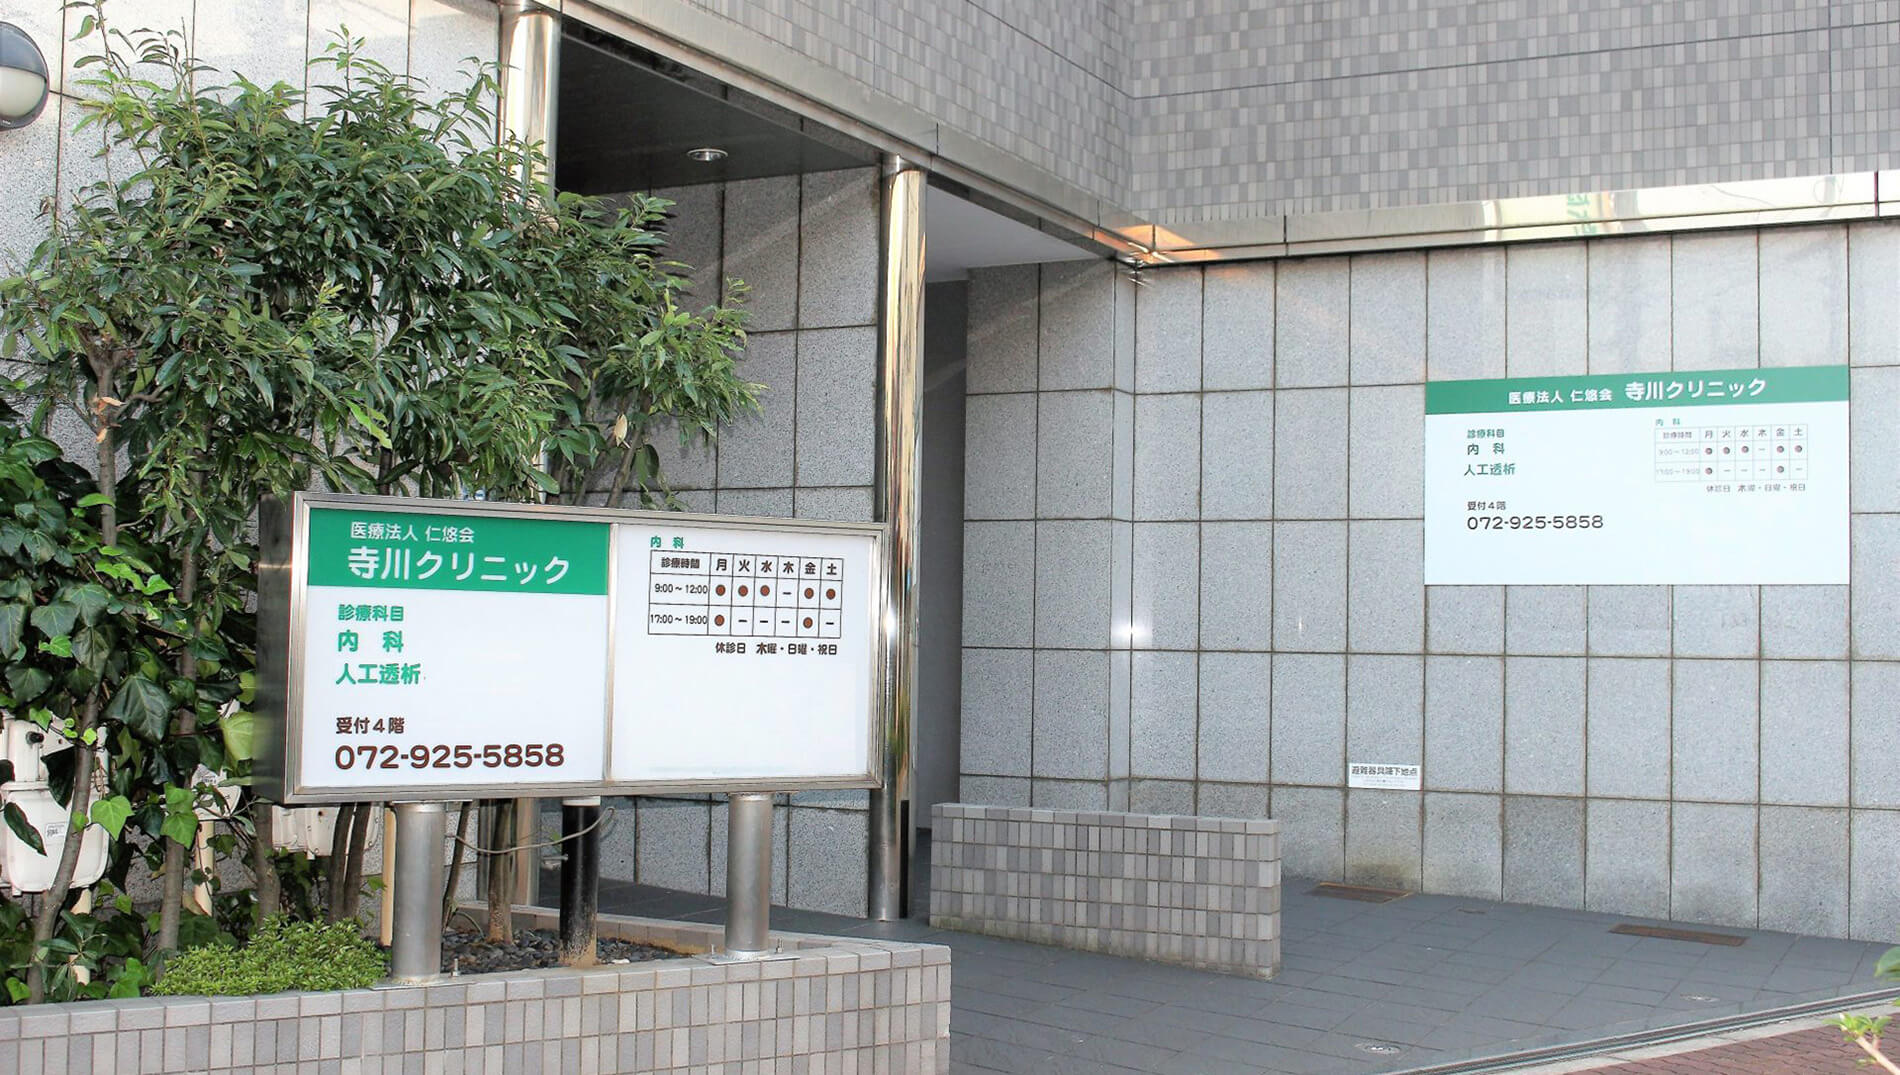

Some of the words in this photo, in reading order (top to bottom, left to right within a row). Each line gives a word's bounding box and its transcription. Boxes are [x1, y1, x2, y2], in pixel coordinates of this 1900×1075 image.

[1509, 390, 1563, 405] 医療法人
[1570, 388, 1612, 402] 仁悠会
[1625, 378, 1766, 400] 寺川クリニック
[1464, 463, 1515, 476] 人工透析
[1467, 515, 1603, 530] 072-925-5858
[351, 522, 418, 541] 医療法人
[425, 526, 474, 543] 仁悠会
[348, 546, 569, 584] 寺川クリニック
[661, 557, 700, 569] 診療時間
[716, 558, 727, 571] 月
[739, 559, 750, 572] 火
[761, 560, 772, 573] 水
[783, 561, 794, 574] 木
[805, 562, 816, 574] 金
[826, 563, 837, 575] 土
[338, 604, 404, 621] 診療科目
[715, 642, 746, 654] 休診日
[336, 663, 421, 685] 人工透析
[335, 743, 564, 770] 072-925-5858
